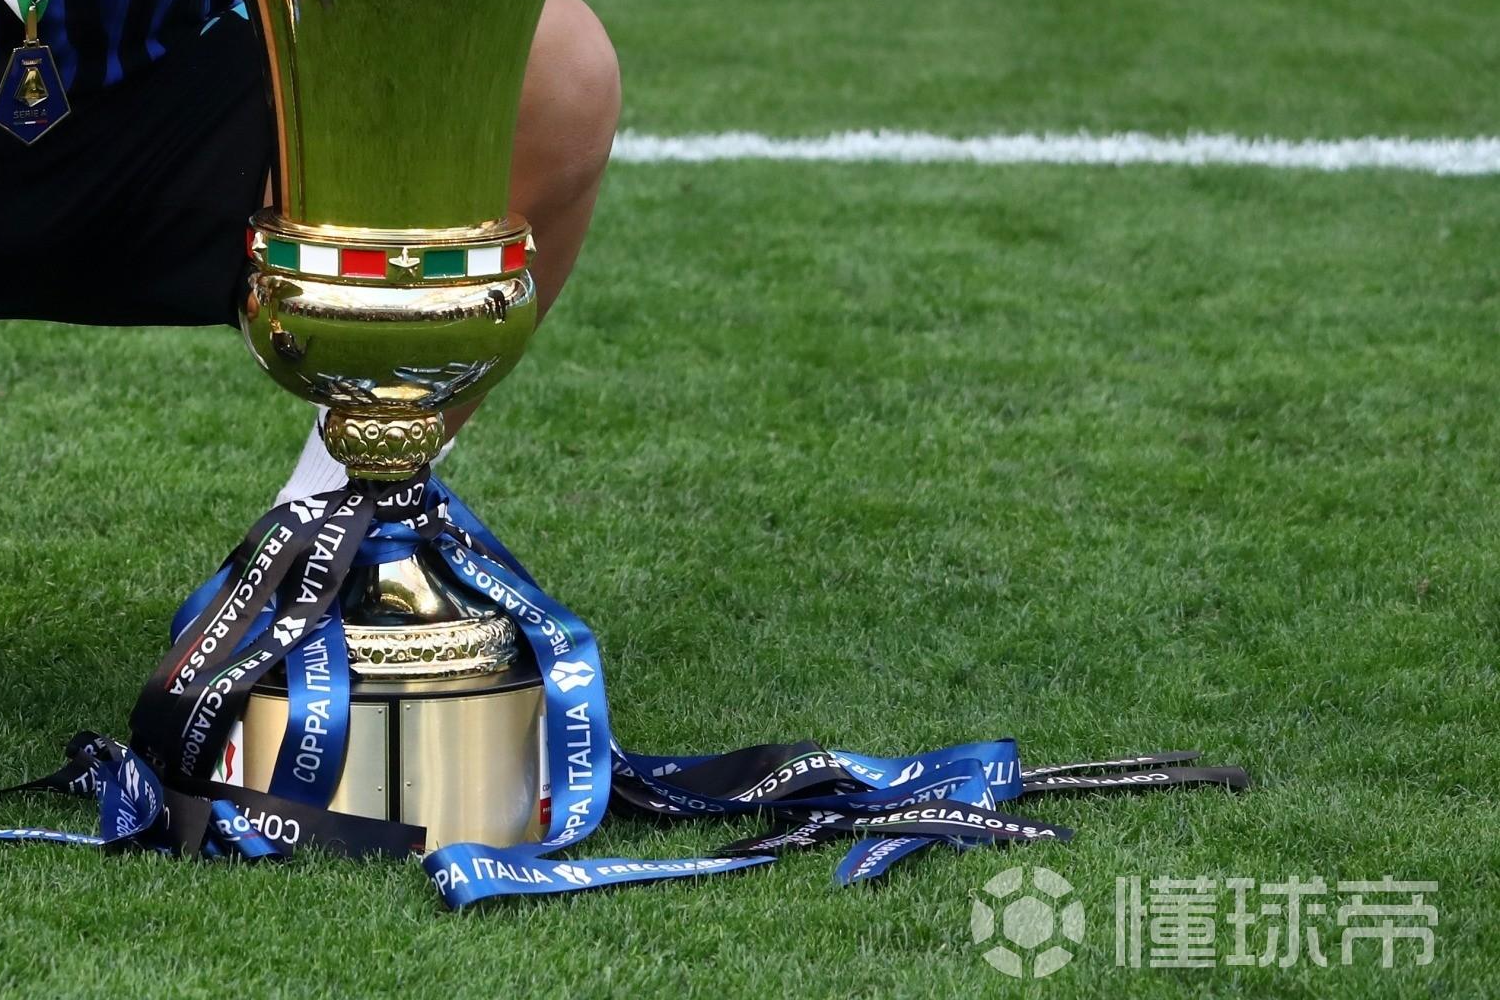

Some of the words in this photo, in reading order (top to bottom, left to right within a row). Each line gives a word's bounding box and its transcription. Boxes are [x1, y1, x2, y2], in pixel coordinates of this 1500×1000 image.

[296, 522, 347, 603] ITALIA
[169, 525, 294, 696] FRECCIAROSSA
[303, 637, 331, 692] ITALIA
[180, 650, 273, 777] FRECCIAROSSA
[293, 699, 331, 784] COPPA
[565, 701, 593, 792] ITALIA
[738, 755, 841, 802] FRECCIA
[854, 808, 1056, 837] FRECCIAROSSA
[471, 857, 554, 884] ITALIA
